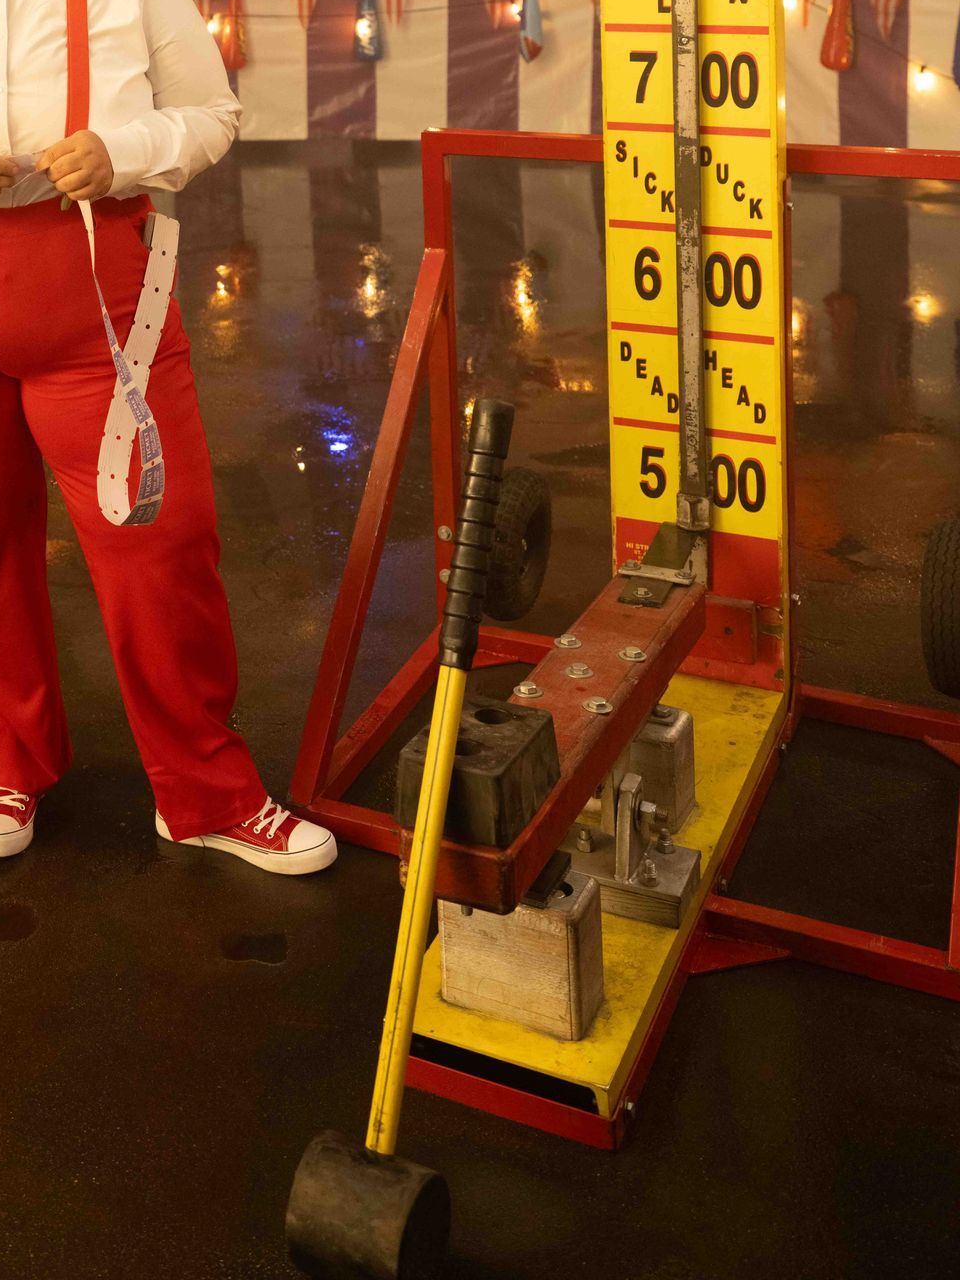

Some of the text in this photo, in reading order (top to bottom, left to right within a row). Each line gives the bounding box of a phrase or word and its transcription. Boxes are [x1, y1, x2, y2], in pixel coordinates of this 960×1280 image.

[629, 50, 759, 109] 7 00
[615, 140, 763, 219] SICK DUCK
[634, 246, 762, 310] 6 00
[620, 341, 767, 424] DEAD HEAD
[143, 432, 152, 458] TICKET
[145, 471, 153, 496] TICKET
[640, 446, 766, 513] 5 00
